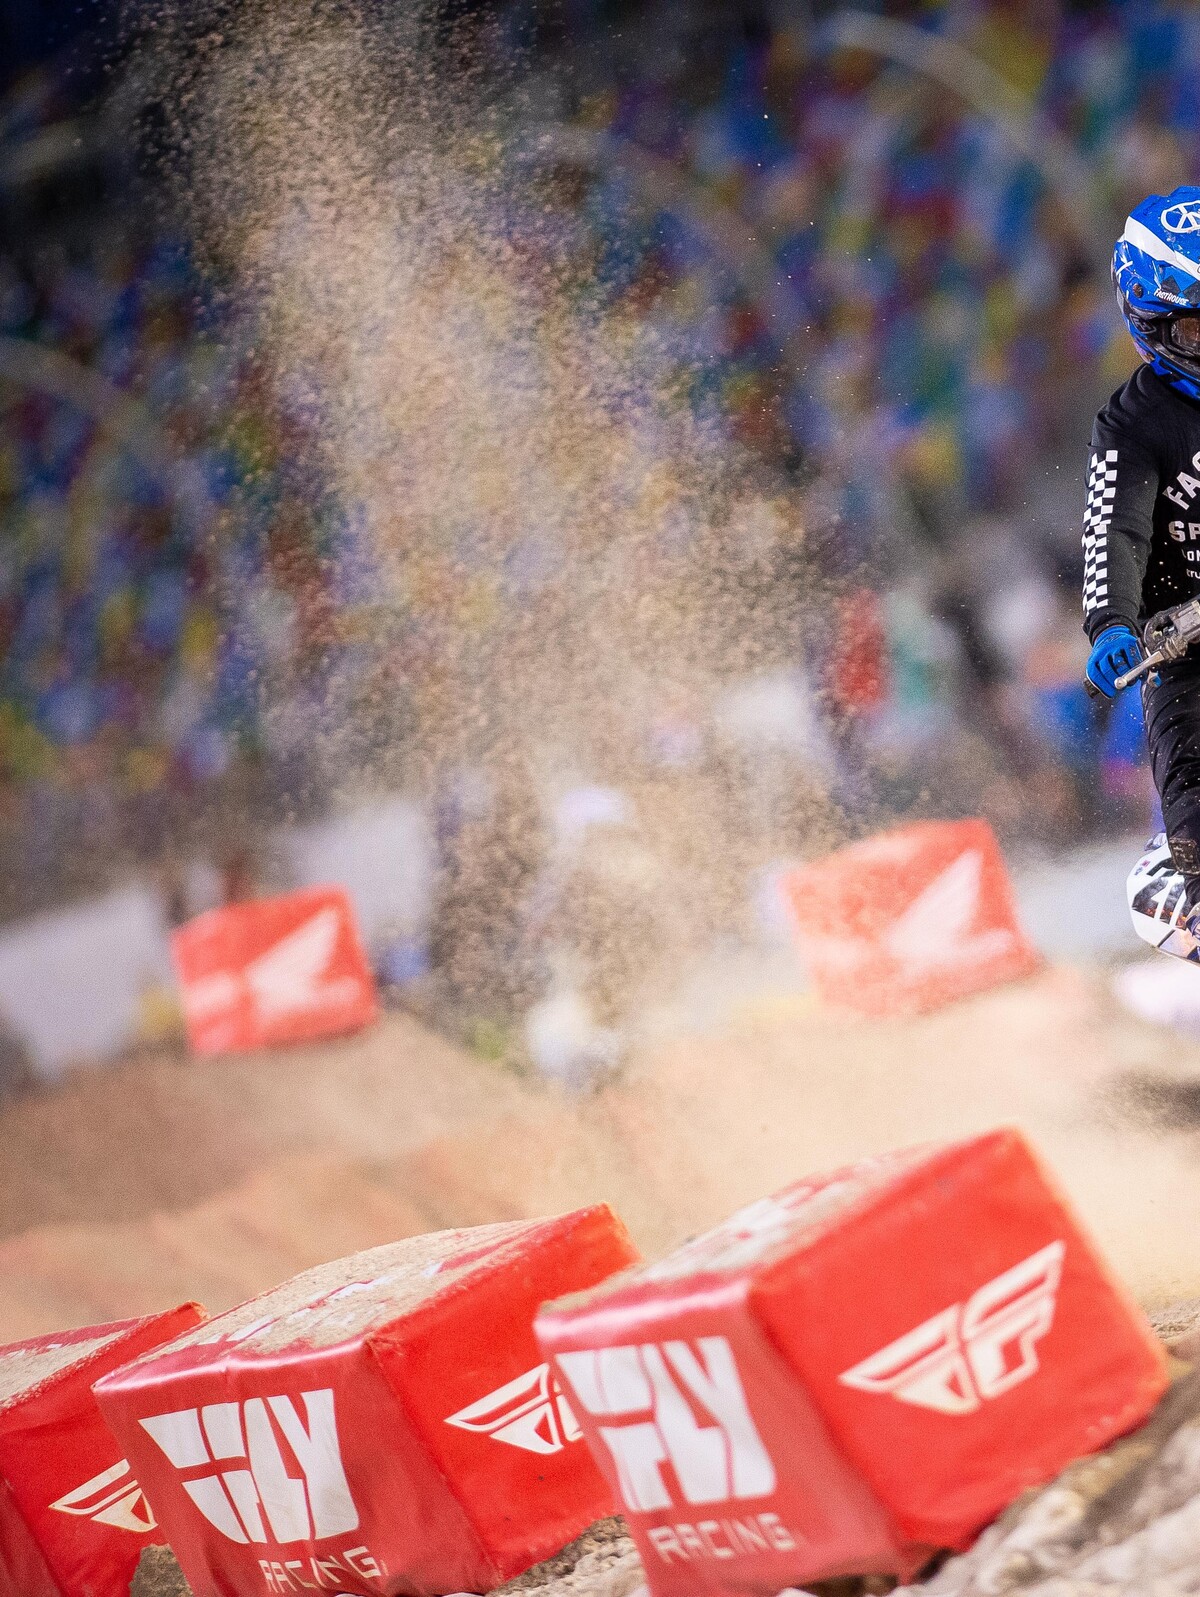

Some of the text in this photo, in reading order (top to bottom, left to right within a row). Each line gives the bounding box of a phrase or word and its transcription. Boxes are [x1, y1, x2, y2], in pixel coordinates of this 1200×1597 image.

[1153, 288, 1190, 306] FASTHOUSE
[554, 1335, 778, 1514] FLY
[137, 1388, 360, 1544] FLY
[646, 1512, 798, 1565] RACING
[258, 1546, 383, 1595] RACING
